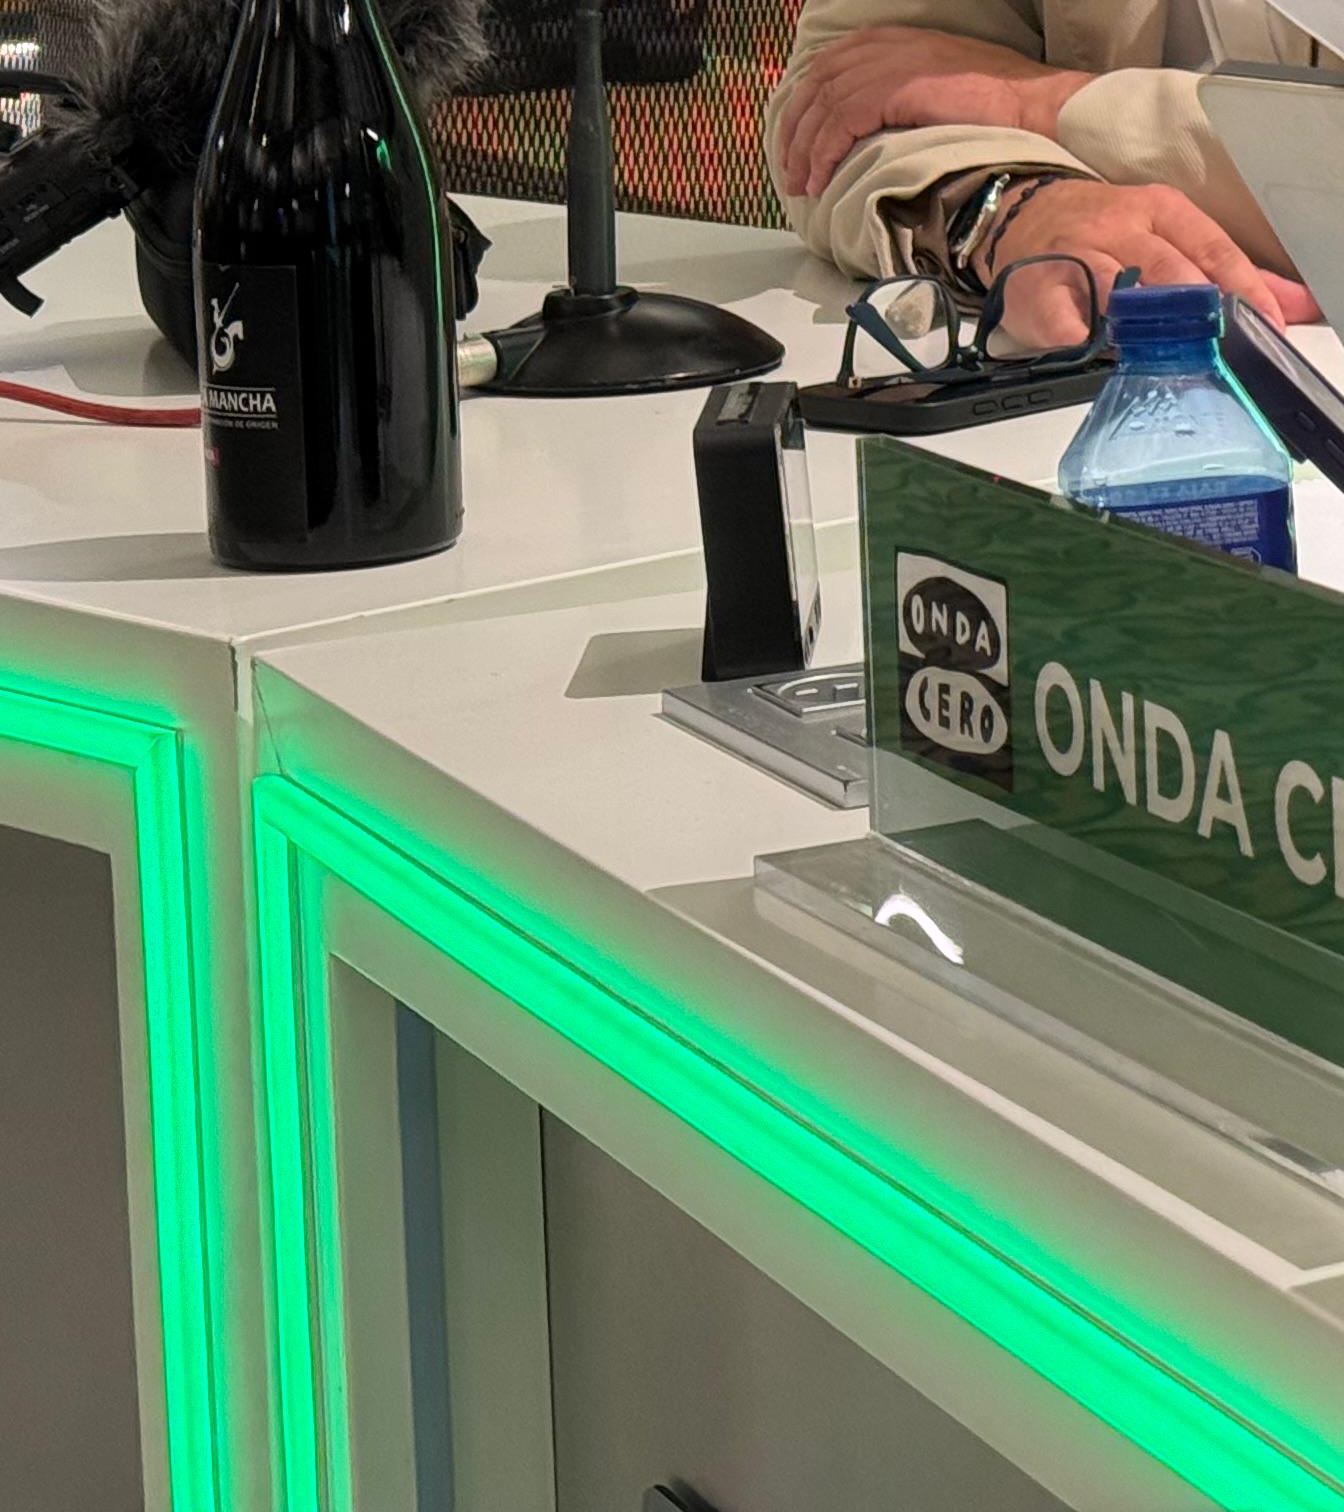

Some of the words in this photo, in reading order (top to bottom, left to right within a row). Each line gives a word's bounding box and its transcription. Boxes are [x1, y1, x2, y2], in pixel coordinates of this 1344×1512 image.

[208, 389, 277, 413] MANCHA
[911, 594, 992, 657] ONDA
[918, 675, 995, 744] CERO
[1034, 661, 1255, 859] ONDA
